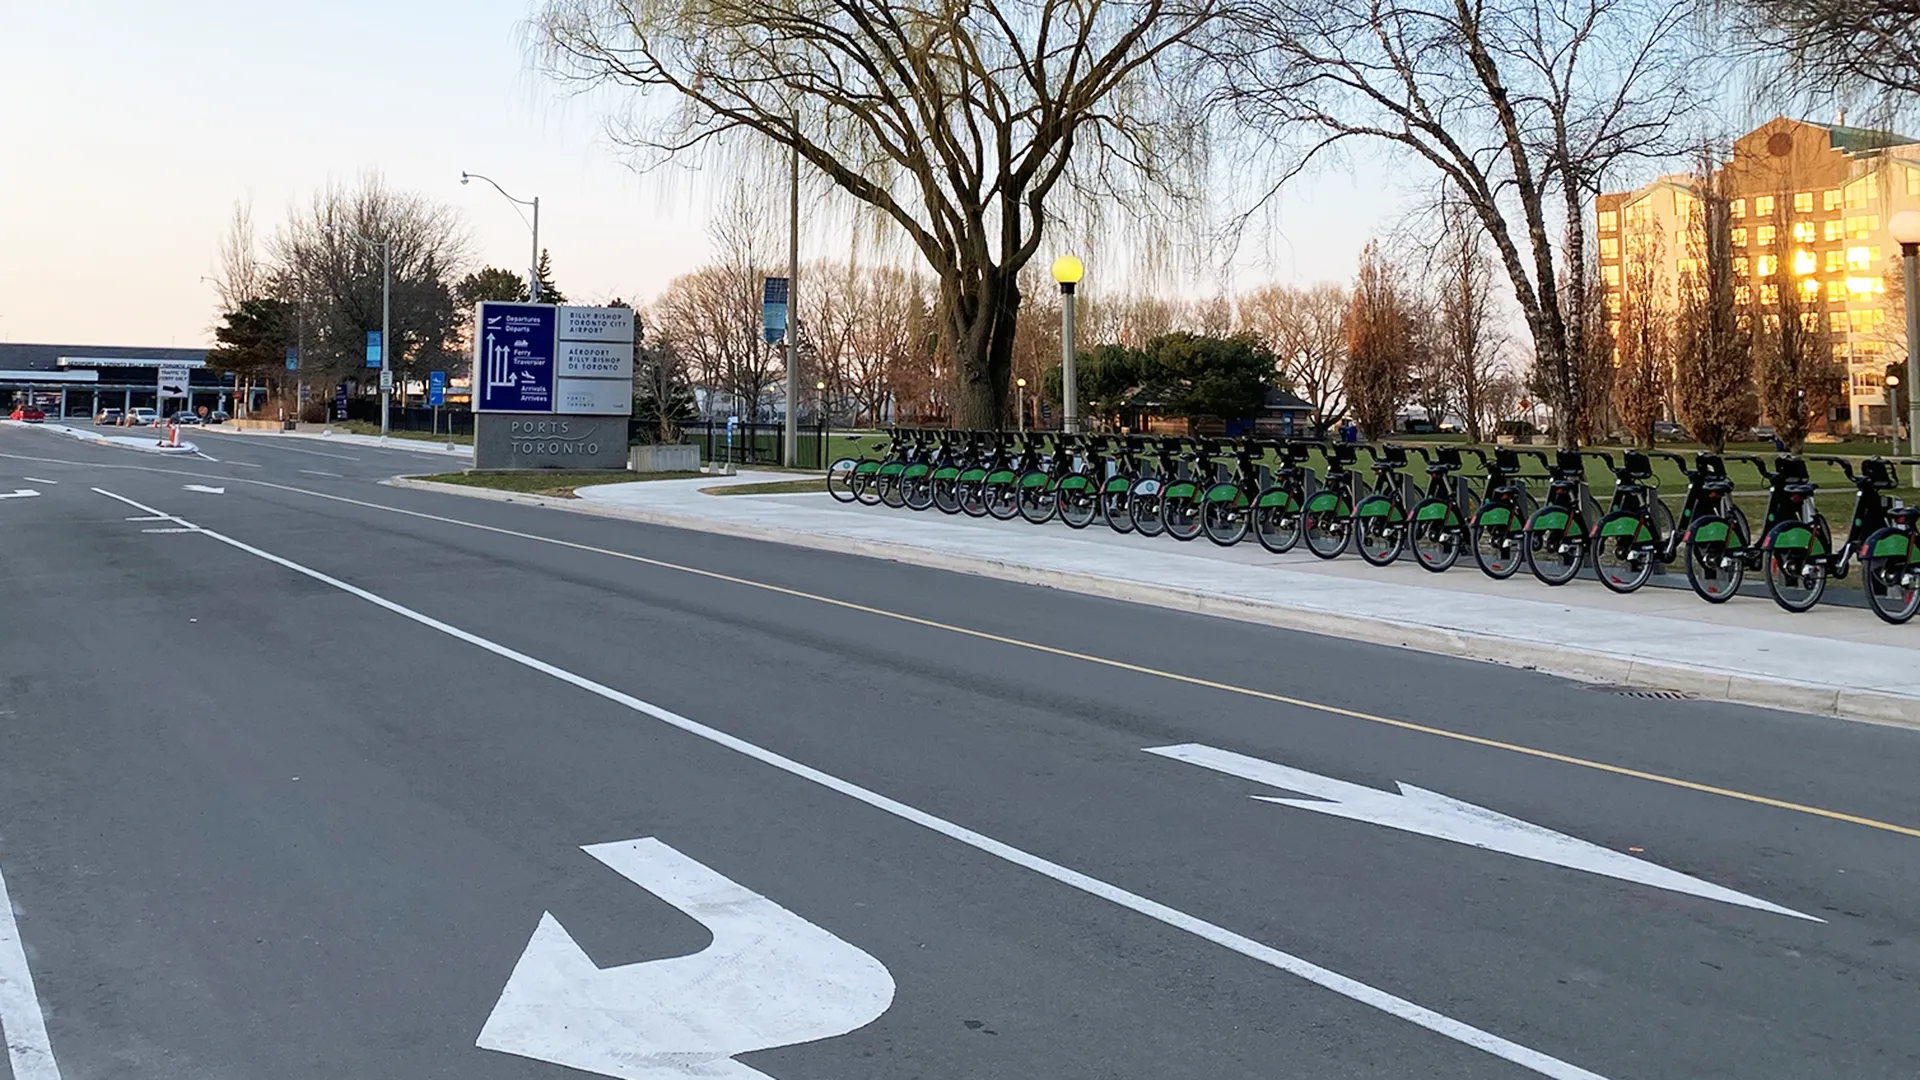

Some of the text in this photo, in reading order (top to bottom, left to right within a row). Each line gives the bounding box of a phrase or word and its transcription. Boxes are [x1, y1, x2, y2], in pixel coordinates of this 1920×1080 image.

[506, 315, 541, 323] Departures
[513, 349, 531, 357] Ferry
[569, 348, 610, 356] AÉROPORT
[513, 358, 545, 366] Traversier
[511, 421, 569, 433] PORTS
[511, 442, 599, 454] TORONTO
